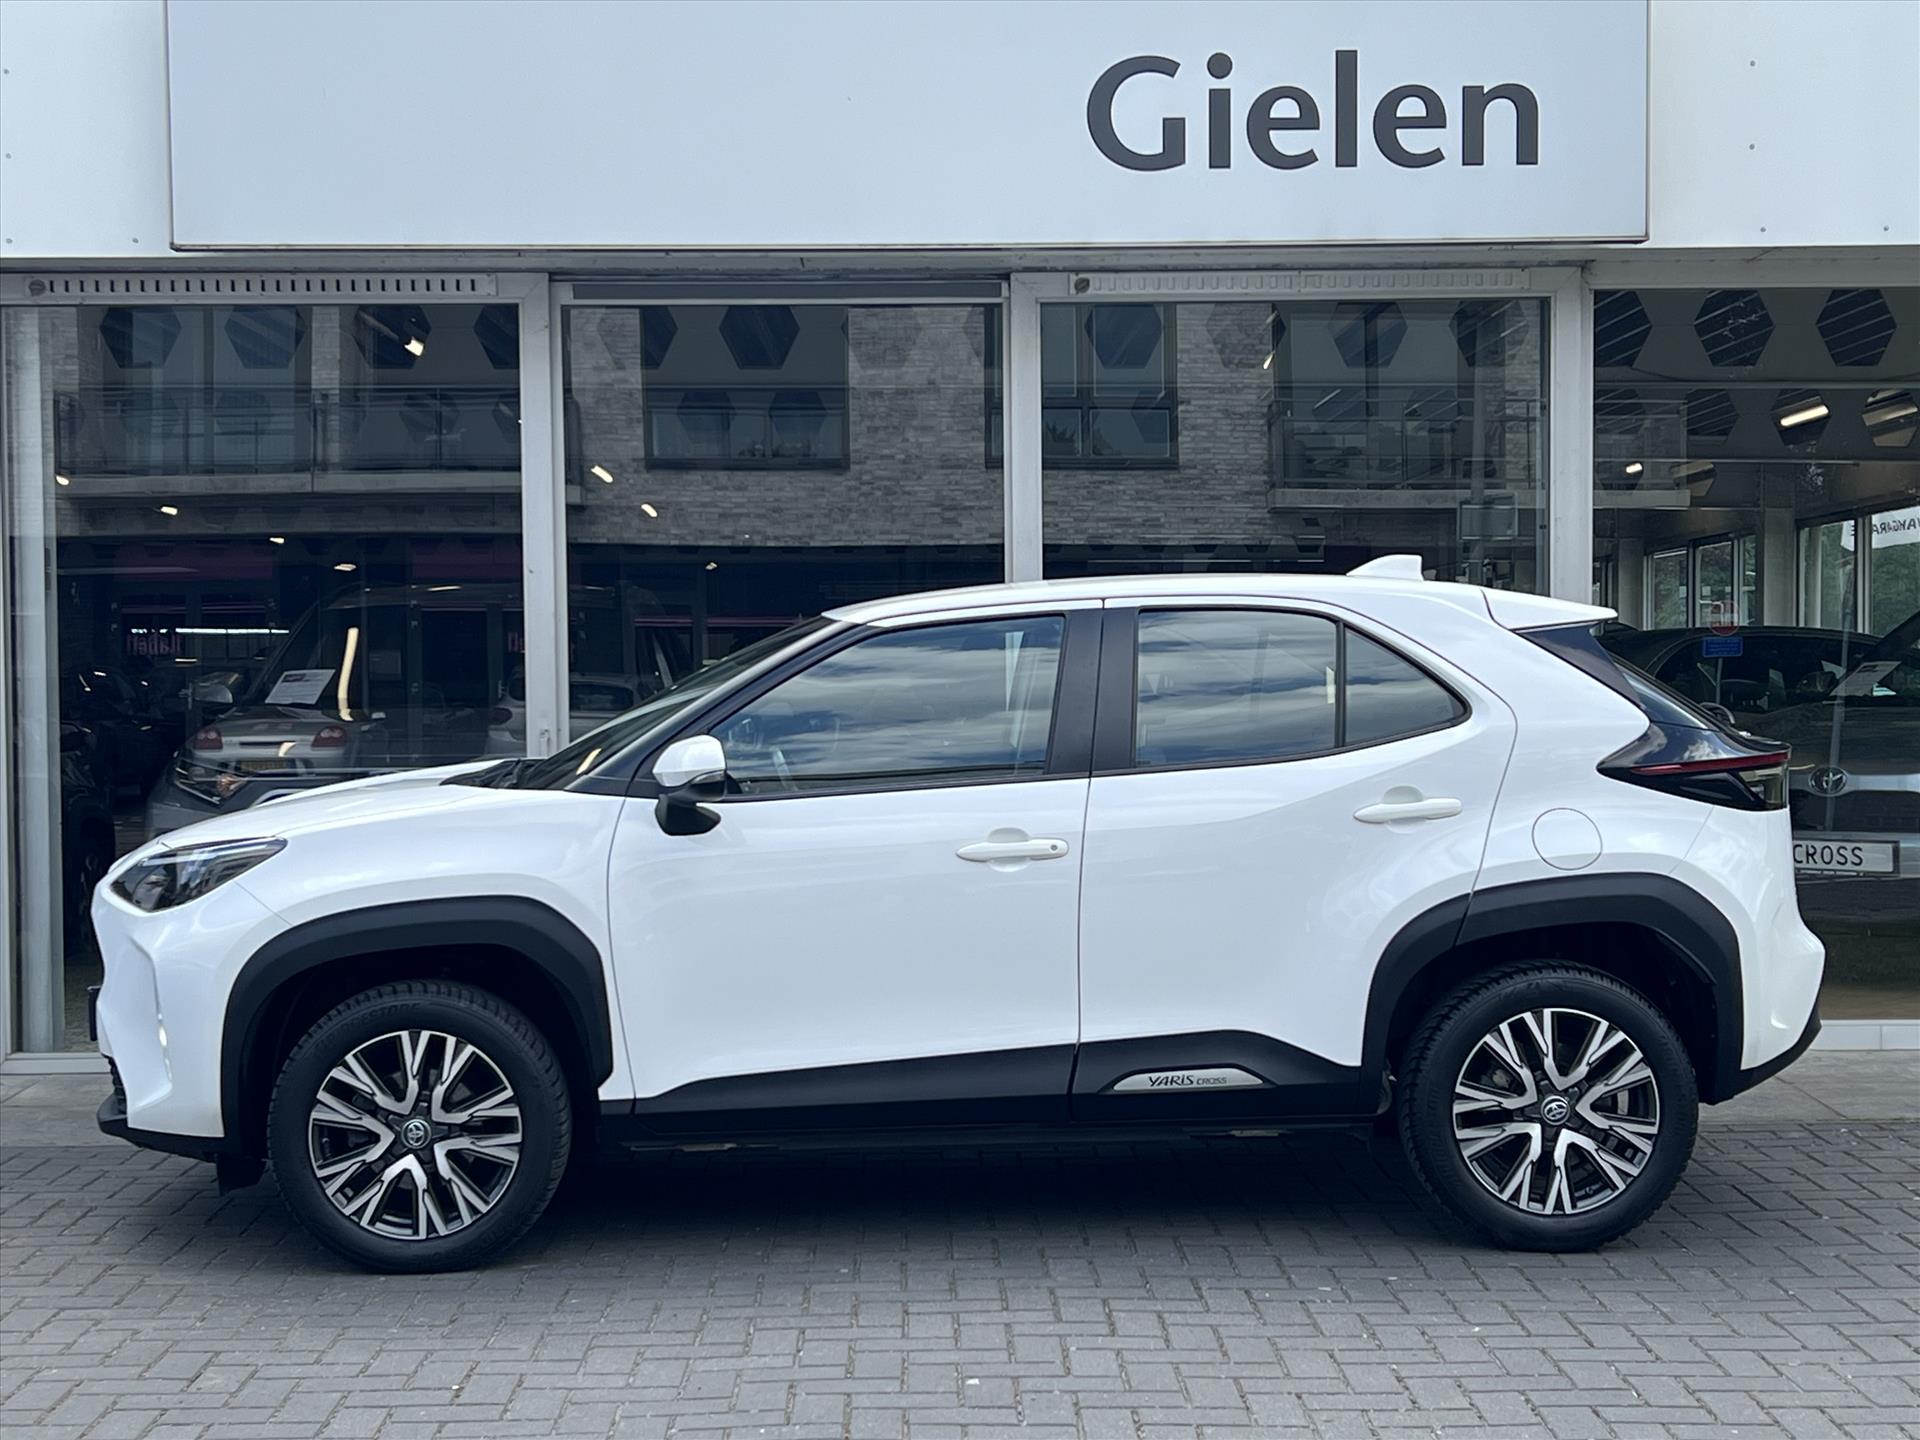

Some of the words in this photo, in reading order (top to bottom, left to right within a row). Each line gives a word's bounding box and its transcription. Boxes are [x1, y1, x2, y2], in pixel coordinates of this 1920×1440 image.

[1087, 50, 1538, 171] Gielen
[1793, 844, 1863, 866] CROSS
[1196, 1077, 1227, 1085] CROSS
